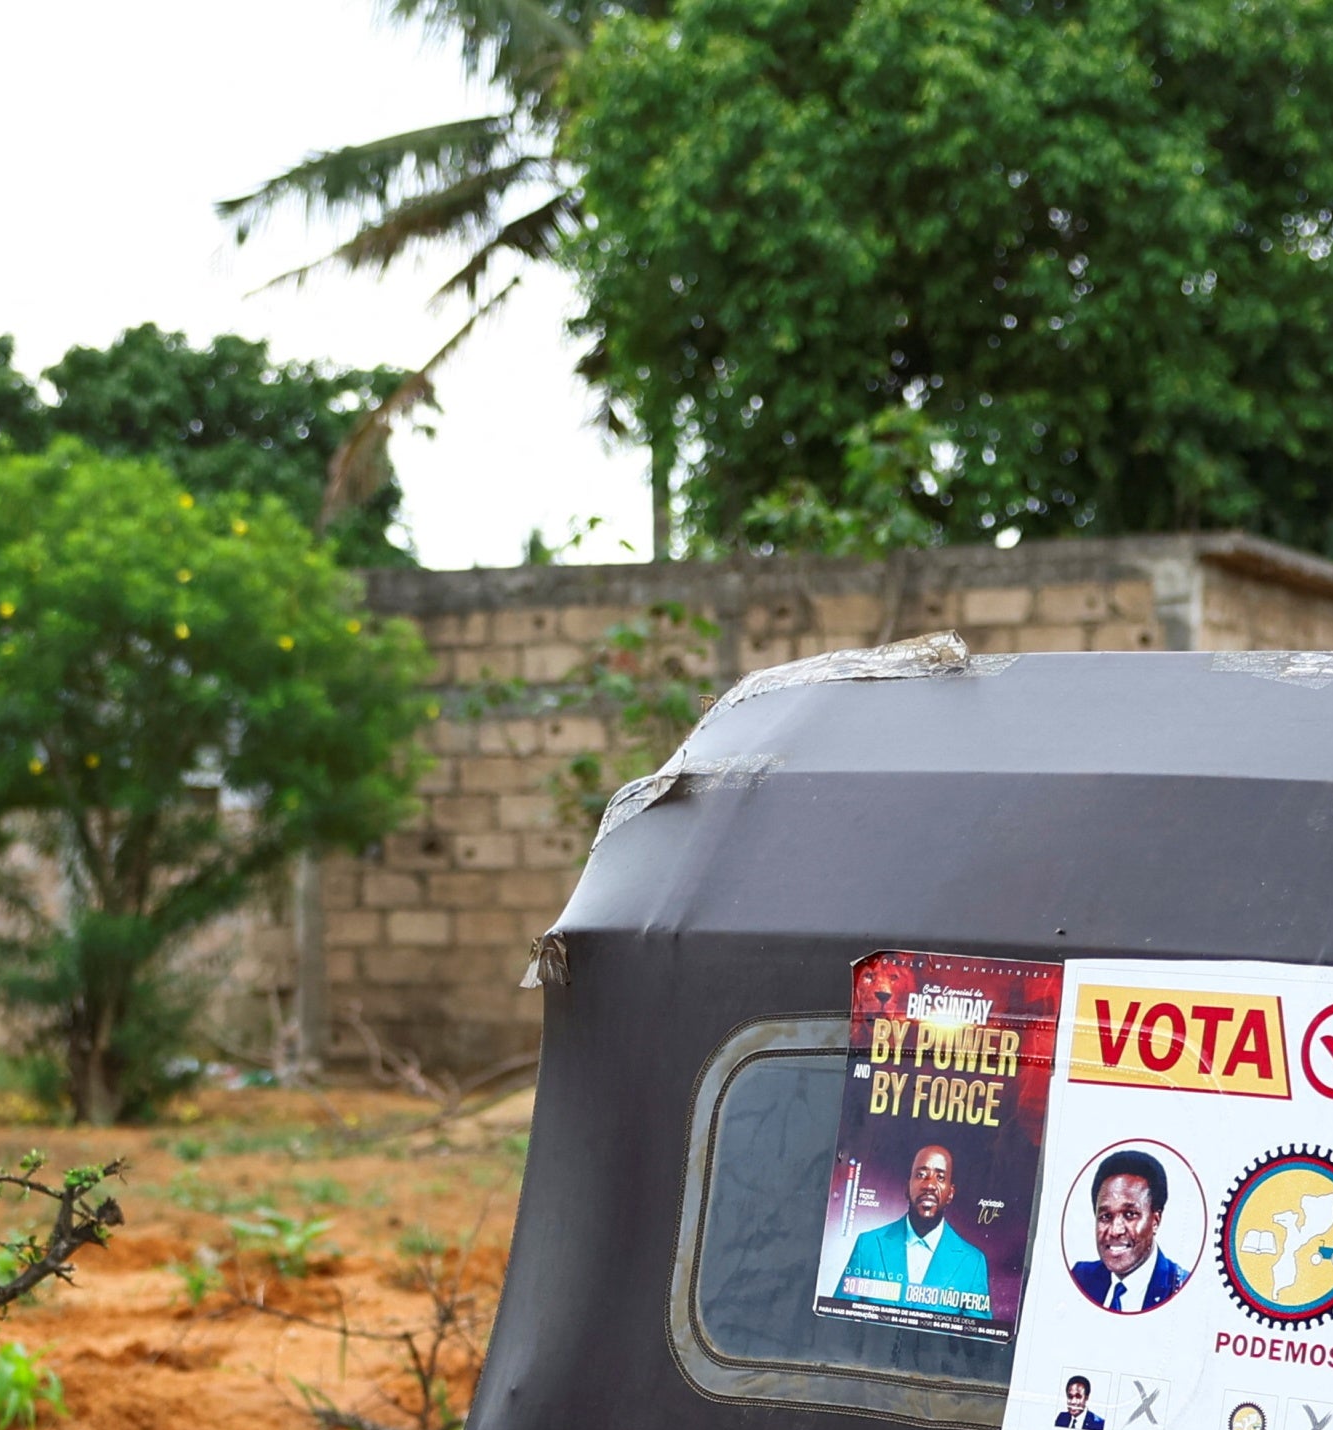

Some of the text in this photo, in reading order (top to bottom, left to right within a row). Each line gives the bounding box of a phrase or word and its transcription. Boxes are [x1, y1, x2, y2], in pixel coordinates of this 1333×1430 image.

[906, 992, 994, 1026] BIG SUNDAY
[870, 1018, 1020, 1077] BY POWER
[1094, 998, 1274, 1080] VOTA
[853, 1063, 871, 1079] AND
[869, 1070, 1005, 1127] BY FORCE
[843, 1277, 856, 1293] 30
[845, 1267, 904, 1281] DOMINGO
[905, 1284, 991, 1312] 08H30 NÃO PERCA
